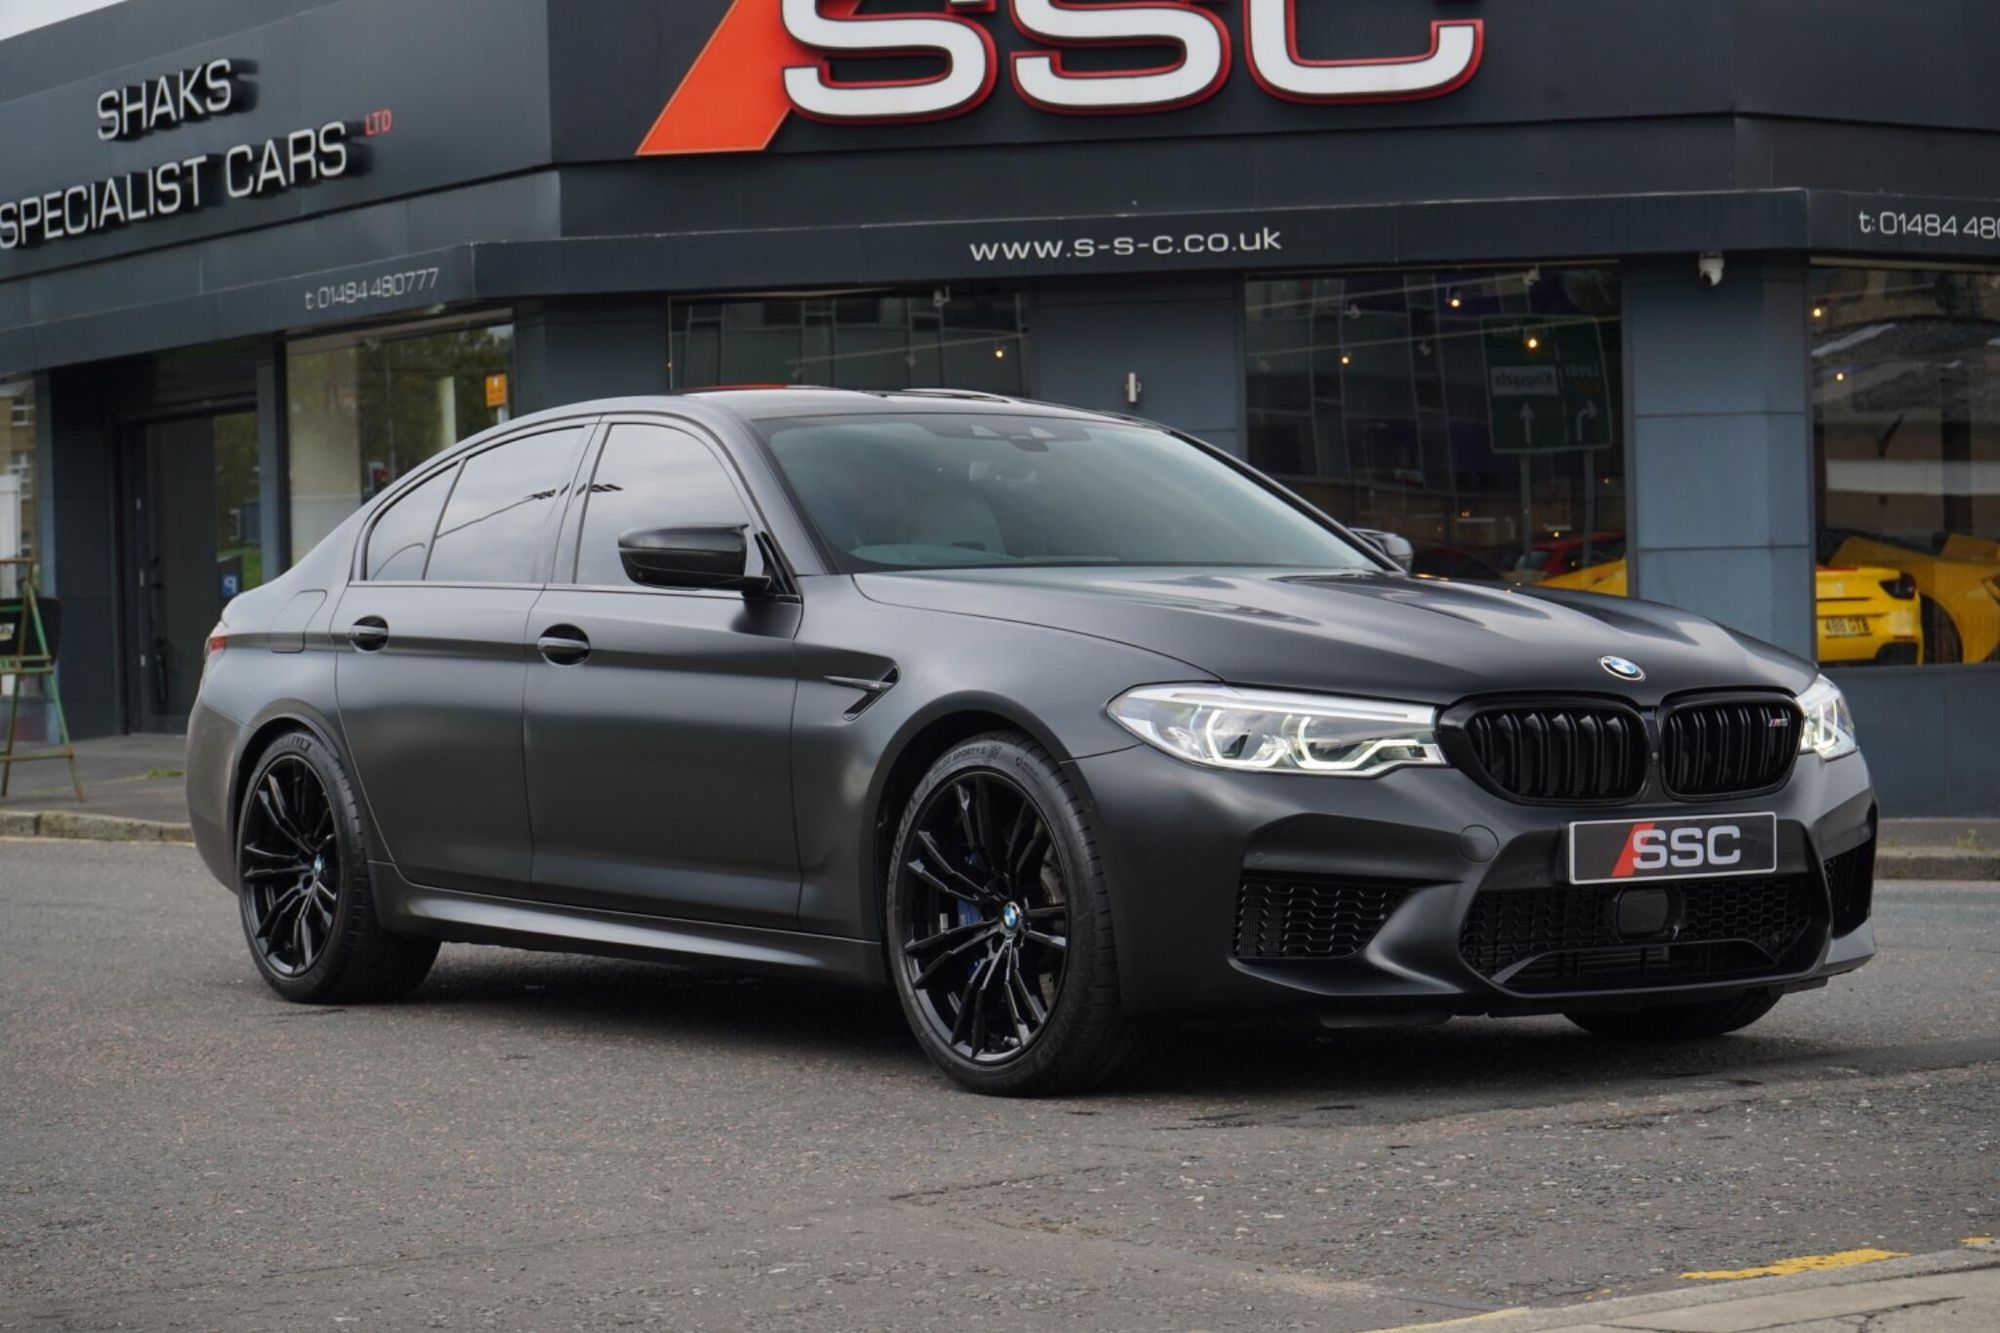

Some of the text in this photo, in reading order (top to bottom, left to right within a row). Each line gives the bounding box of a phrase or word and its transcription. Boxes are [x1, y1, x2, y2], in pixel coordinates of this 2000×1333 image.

[782, 0, 1484, 123] SSC
[97, 58, 232, 140] SHAKS
[0, 109, 392, 249] SPECIALIST CARS LTD
[969, 227, 1282, 261] www.s-s-c.co.uk
[1962, 215, 2000, 239] 48
[369, 267, 439, 297] 480777
[1632, 825, 1741, 869] SSC
